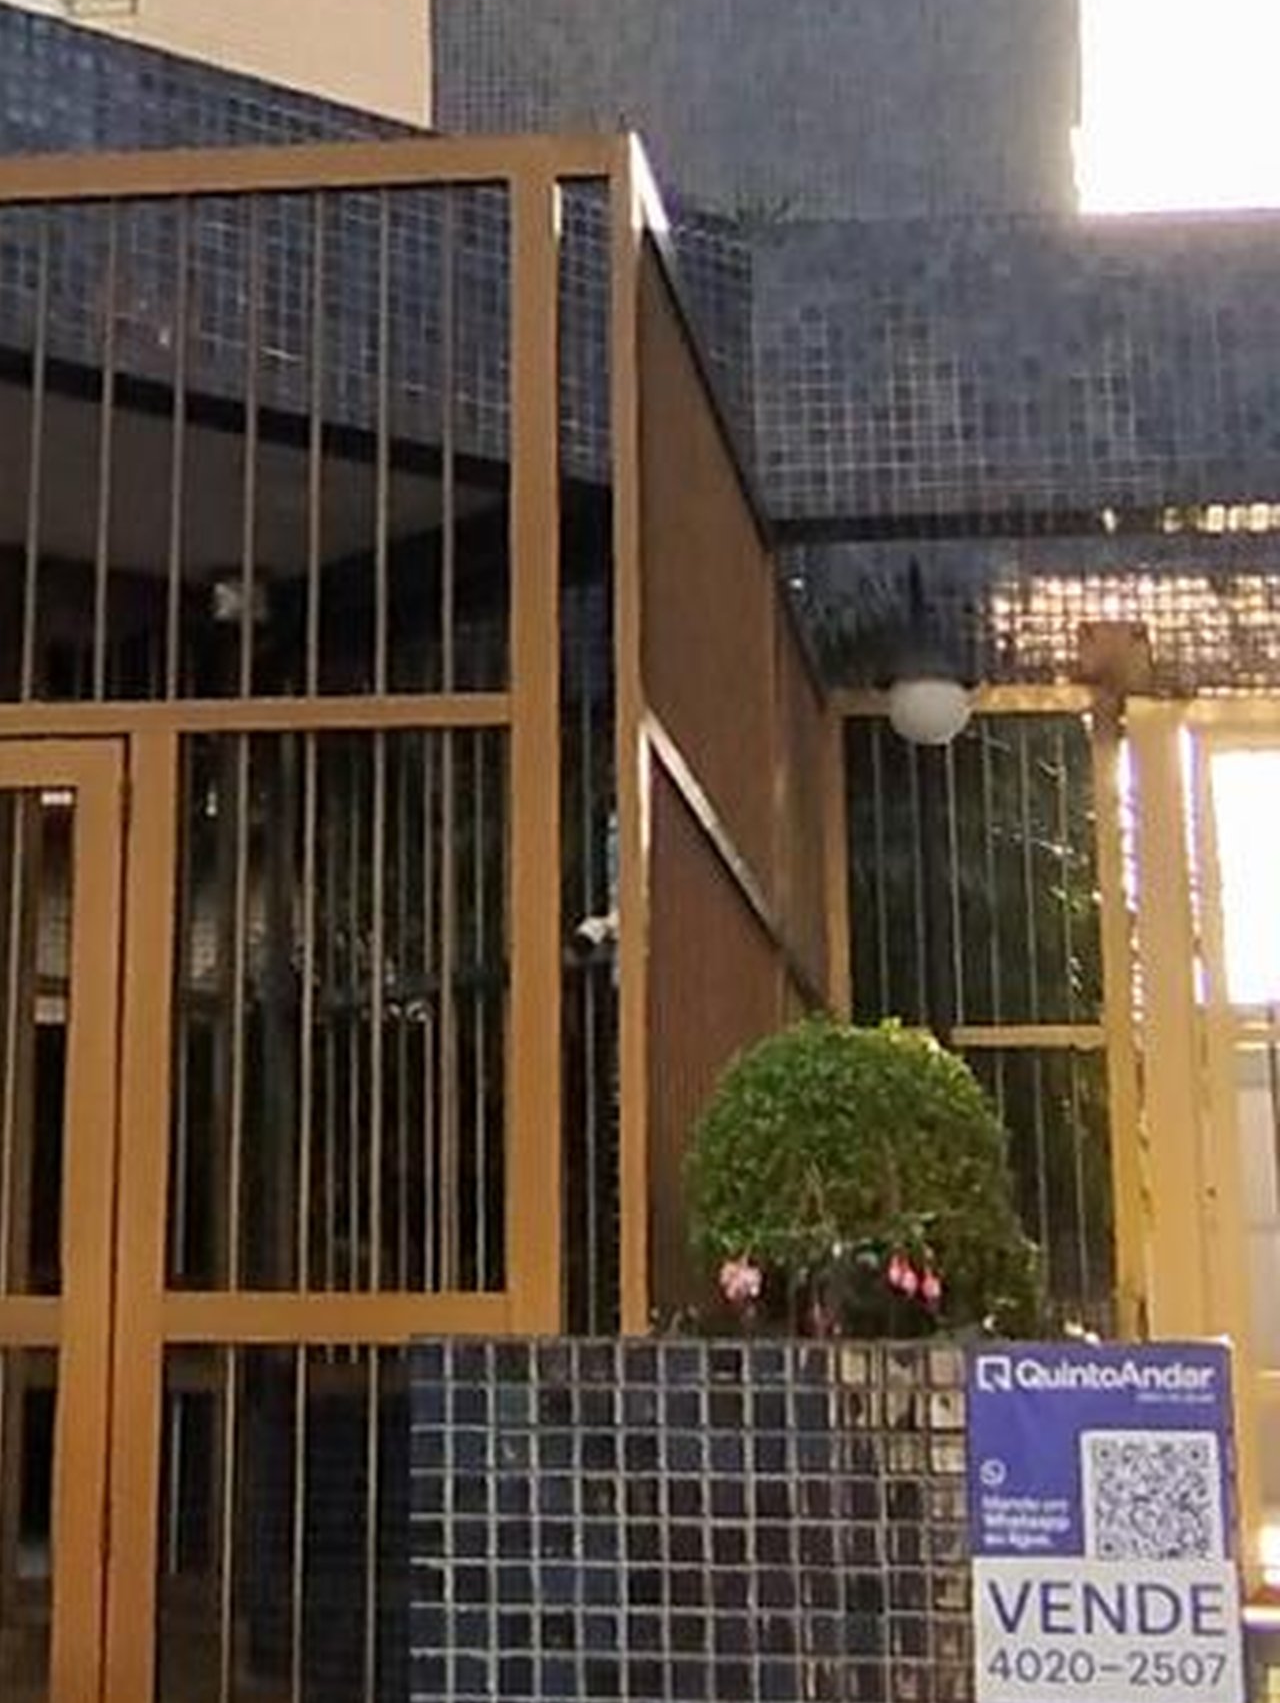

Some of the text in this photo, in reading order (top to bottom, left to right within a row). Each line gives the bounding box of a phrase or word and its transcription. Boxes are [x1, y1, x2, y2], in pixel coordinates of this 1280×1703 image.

[1015, 1358, 1216, 1391] QuintoAndar
[987, 1579, 1226, 1637] VENDE
[987, 1648, 1227, 1687] 4020-2507
